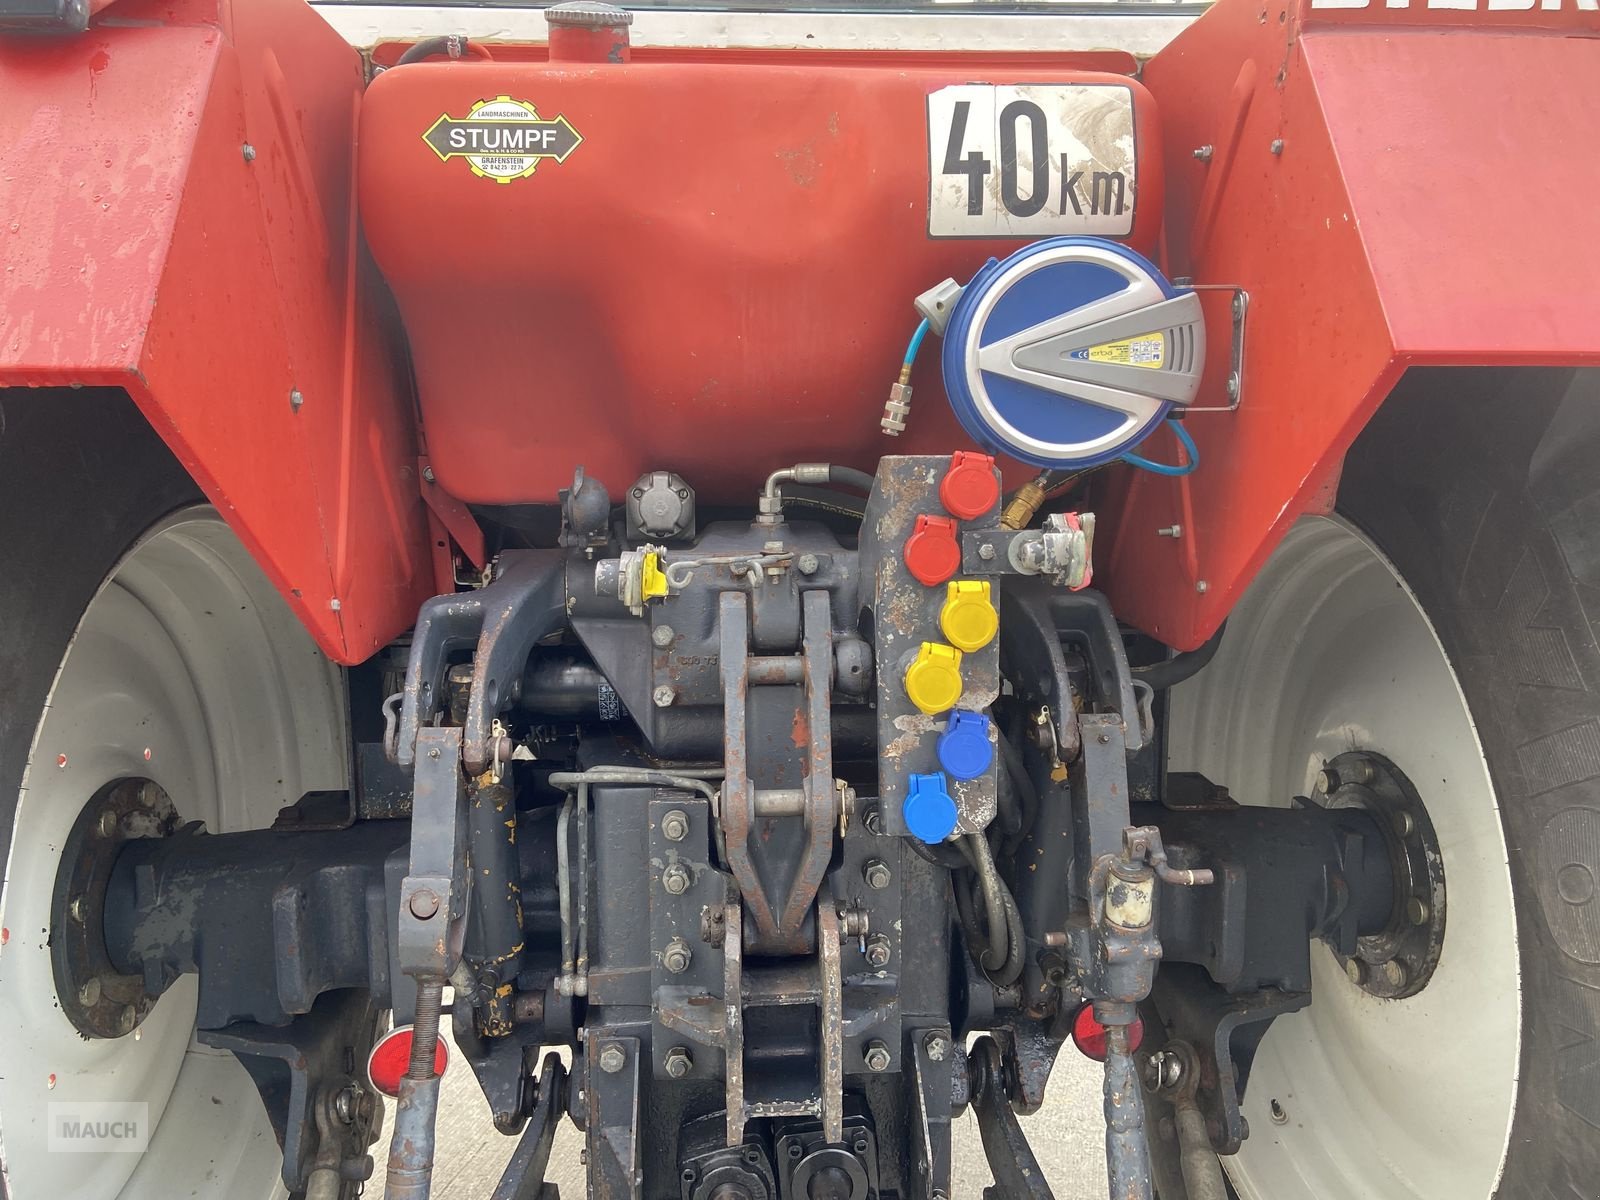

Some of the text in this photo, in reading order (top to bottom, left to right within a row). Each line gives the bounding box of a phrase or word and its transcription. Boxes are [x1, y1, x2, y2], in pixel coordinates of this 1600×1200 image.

[449, 128, 557, 149] STUMPF
[942, 100, 1126, 218] 40 km
